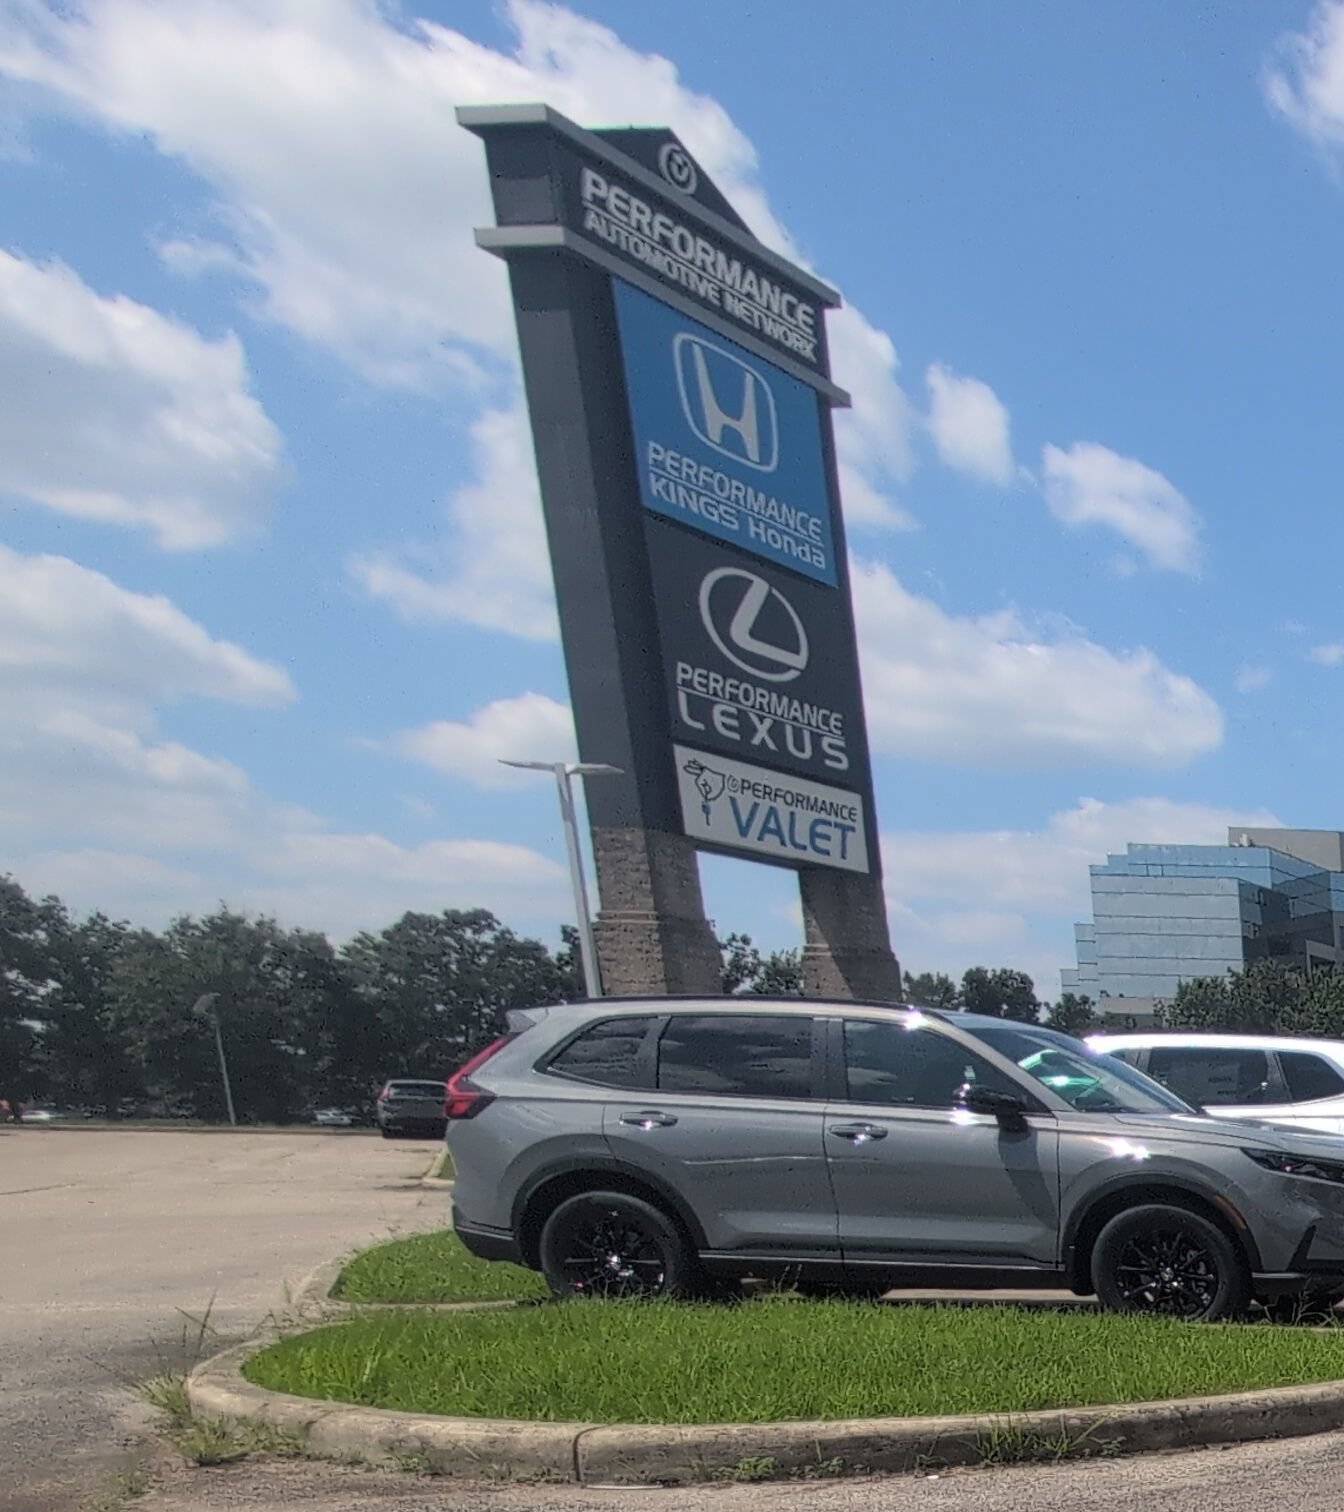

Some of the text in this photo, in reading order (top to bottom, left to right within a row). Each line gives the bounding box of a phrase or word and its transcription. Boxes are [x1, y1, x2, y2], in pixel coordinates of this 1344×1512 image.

[582, 167, 814, 334] PERFORMANCE
[584, 210, 817, 363] AUTOMOTIVE NETWORK
[648, 440, 822, 541] PERFORMANCE
[650, 472, 826, 570] KINGS Honda
[676, 661, 843, 735] PERFORMANCE
[678, 690, 849, 770] LEXUS
[728, 795, 857, 860] VALET
[740, 778, 857, 822] PERFORMANCE
